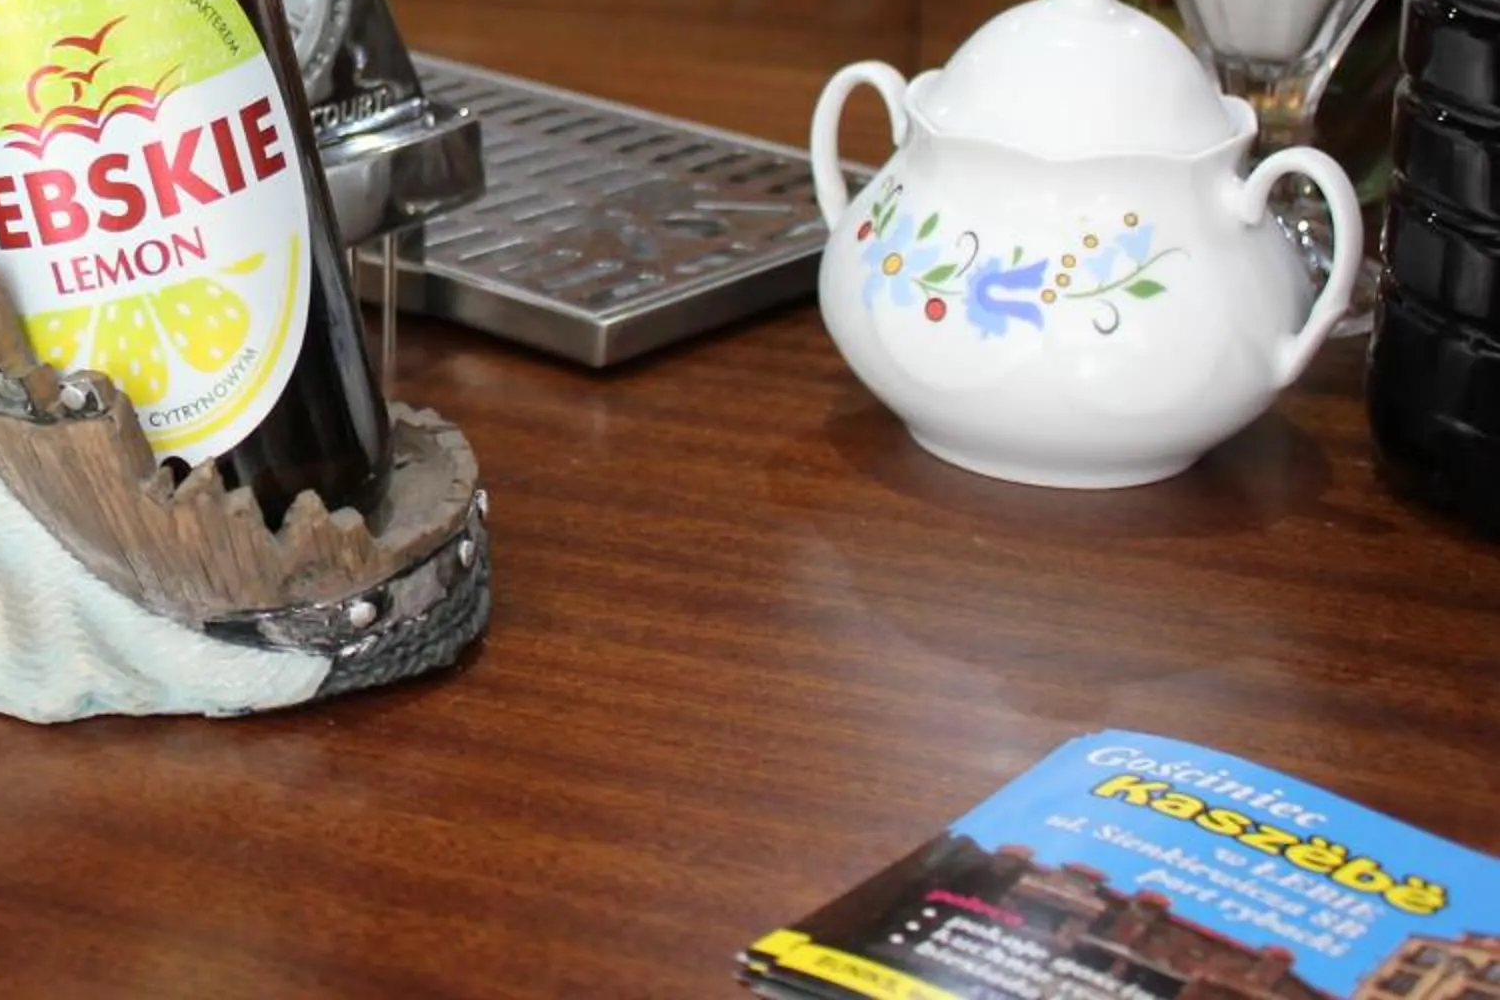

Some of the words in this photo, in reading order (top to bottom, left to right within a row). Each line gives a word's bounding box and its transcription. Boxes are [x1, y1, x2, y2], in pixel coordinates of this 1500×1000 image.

[50, 226, 208, 296] LEMON
[148, 347, 260, 427] CYTRYNOWYM
[1085, 745, 1328, 829] Gościniec
[1092, 773, 1451, 916] Kaszëbë
